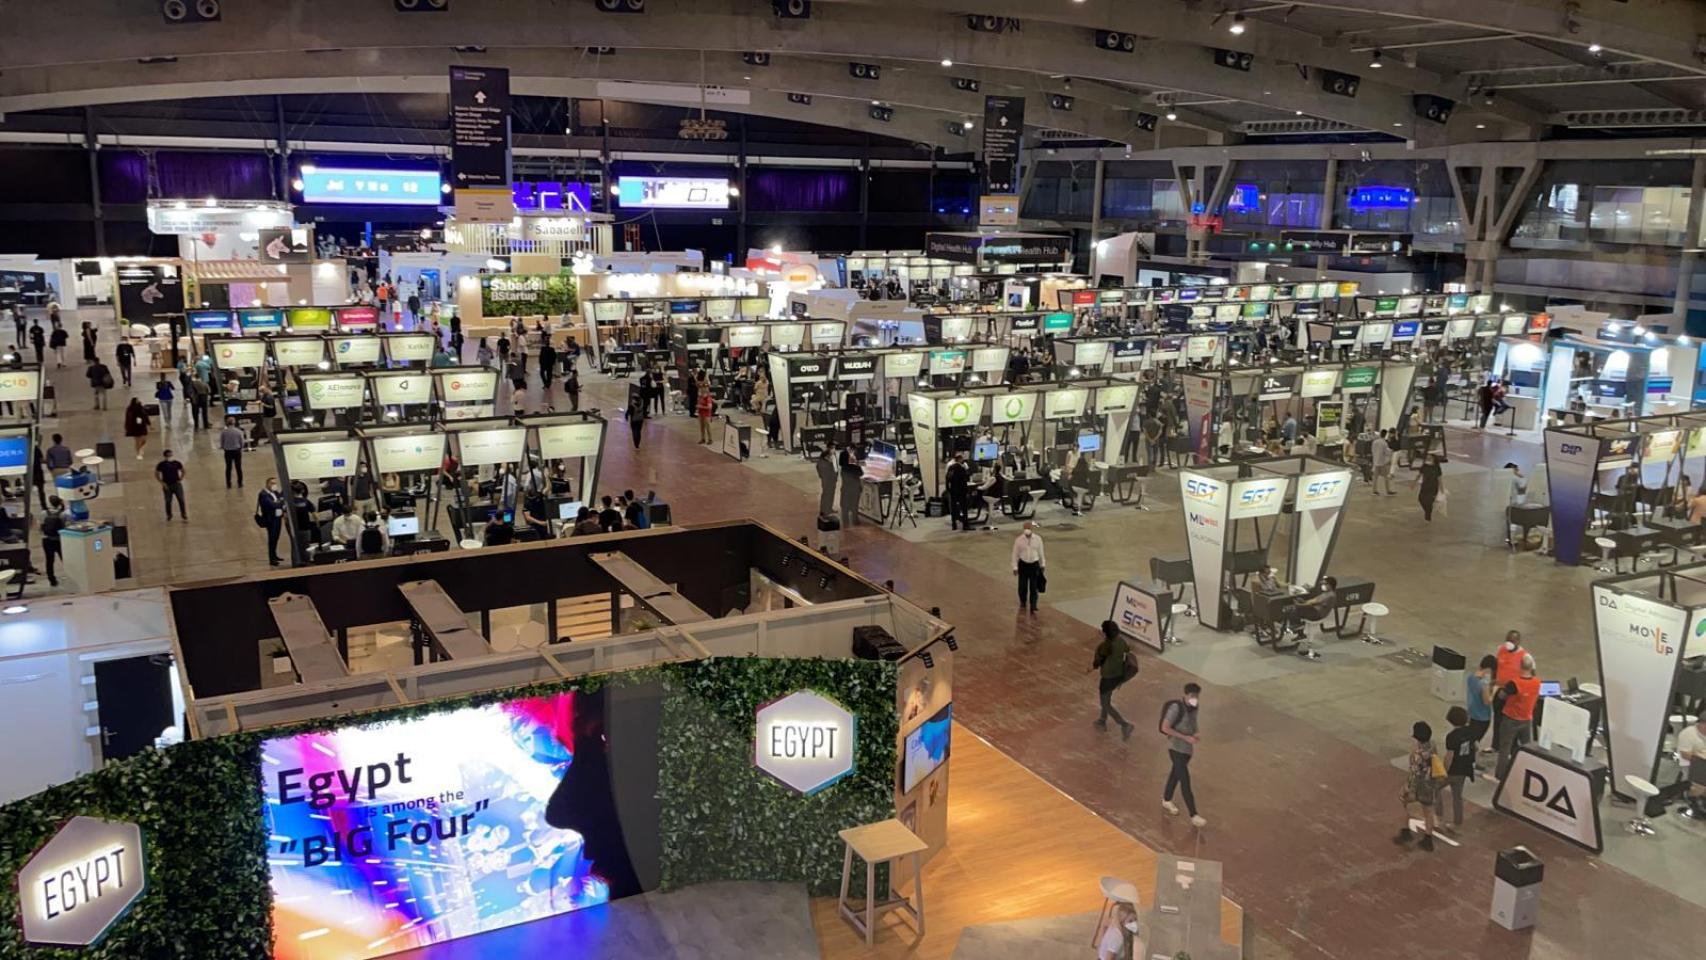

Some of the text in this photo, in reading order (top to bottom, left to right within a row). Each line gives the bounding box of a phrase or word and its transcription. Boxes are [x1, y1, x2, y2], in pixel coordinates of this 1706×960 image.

[535, 224, 583, 235] Sabadell
[962, 244, 973, 254] Hub
[1043, 246, 1058, 255] Hub
[490, 277, 547, 290] Sabadell
[491, 291, 537, 302] BStartup
[1187, 479, 1219, 500] SGT
[1241, 487, 1277, 503] SGT
[1308, 480, 1342, 496] SGT
[1123, 610, 1153, 633] SGT
[1629, 623, 1668, 643] MOVE
[771, 725, 838, 759] EGYPT
[277, 752, 412, 810] Egypt
[381, 795, 436, 815] among
[439, 788, 465, 804] the
[1522, 768, 1577, 819] DA
[43, 848, 125, 920] EGYPT
